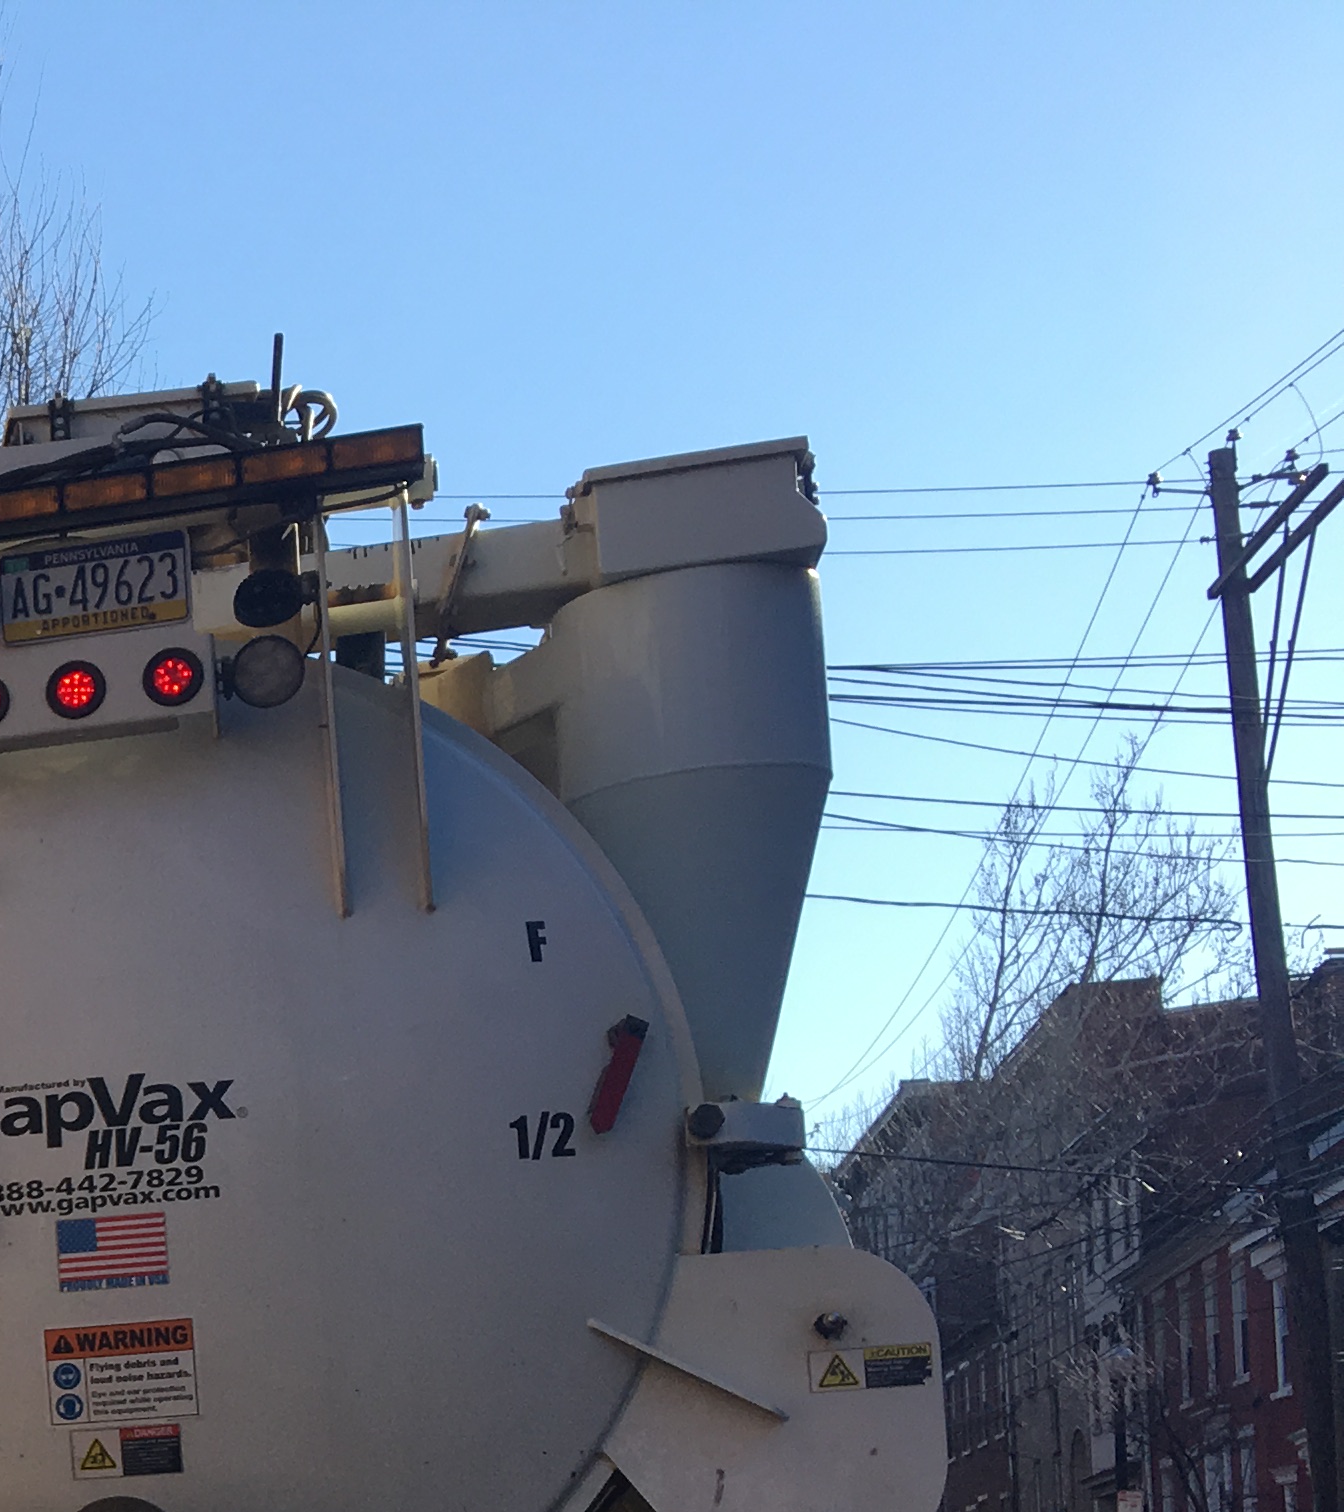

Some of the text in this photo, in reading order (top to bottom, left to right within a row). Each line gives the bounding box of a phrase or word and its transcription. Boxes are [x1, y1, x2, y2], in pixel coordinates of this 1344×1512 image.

[44, 542, 139, 566] PENNSYLVANIA
[525, 920, 547, 962] F
[73, 1078, 86, 1088] by
[509, 1111, 576, 1160] 1/2
[83, 1121, 208, 1170] HV-56
[74, 1325, 189, 1352] WARNING
[876, 1345, 928, 1358] CAUTION
[89, 1357, 179, 1372] Flying debris and
[90, 1375, 113, 1385] loud
[115, 1373, 144, 1383] noise
[134, 1426, 173, 1438] DANGER
